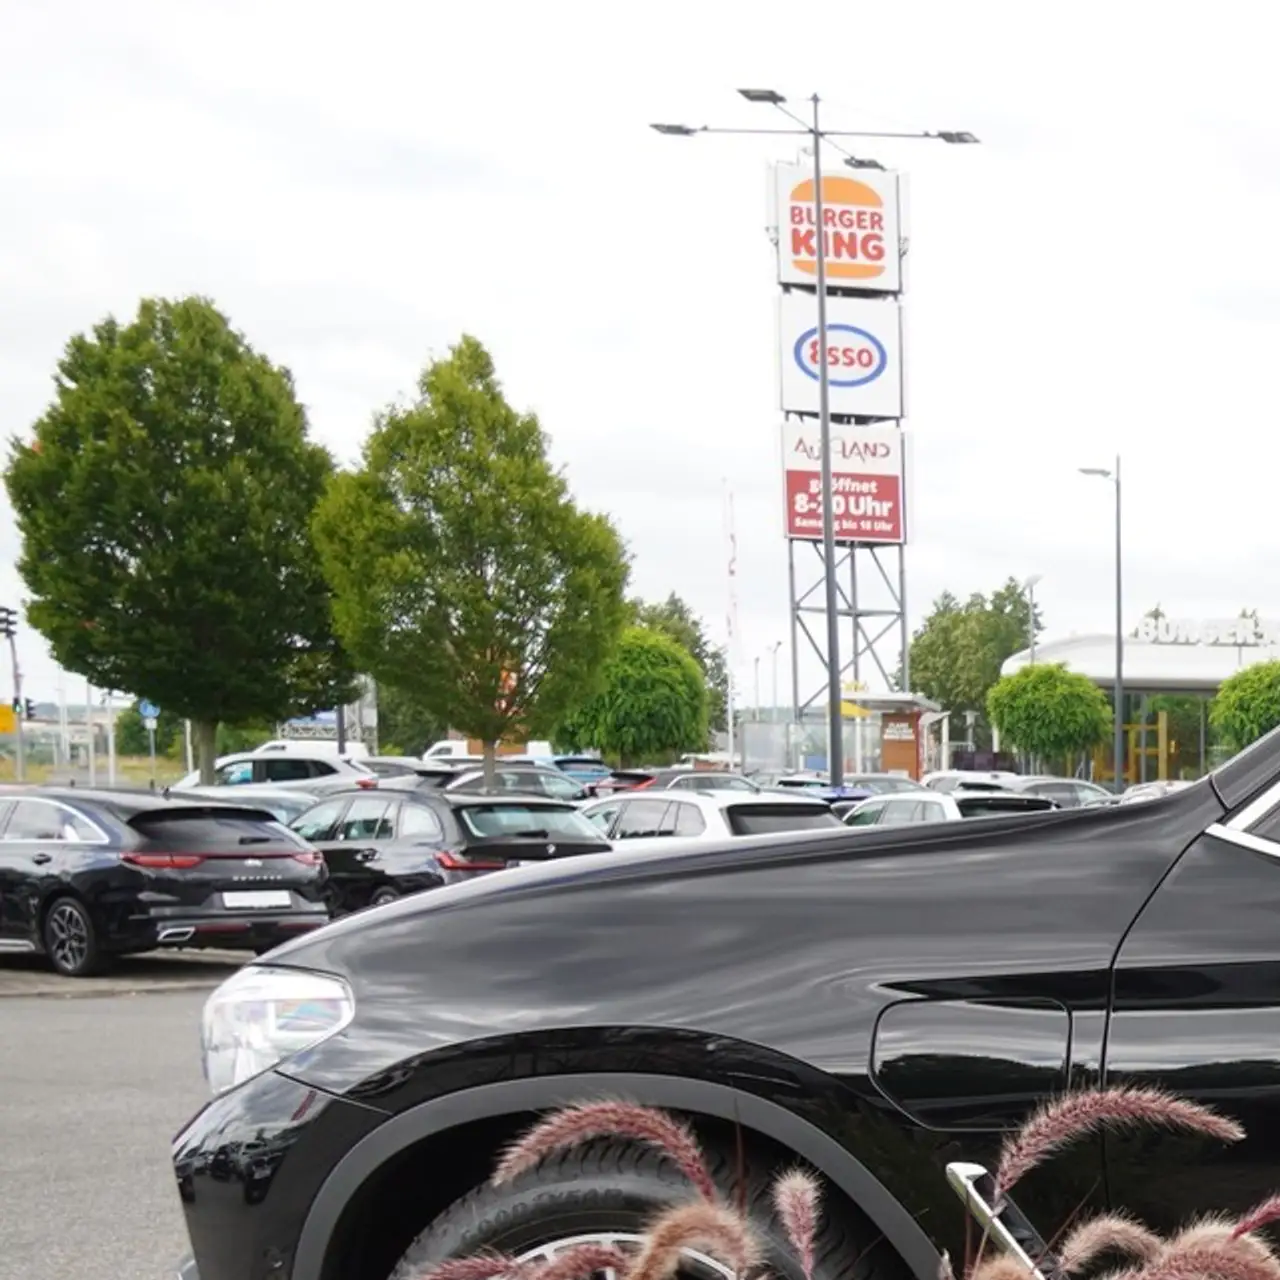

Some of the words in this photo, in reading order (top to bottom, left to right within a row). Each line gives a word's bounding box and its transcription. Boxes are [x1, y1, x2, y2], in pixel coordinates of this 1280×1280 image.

[790, 206, 884, 230] BURGER
[791, 228, 885, 262] KING
[848, 495, 893, 517] Uhr
